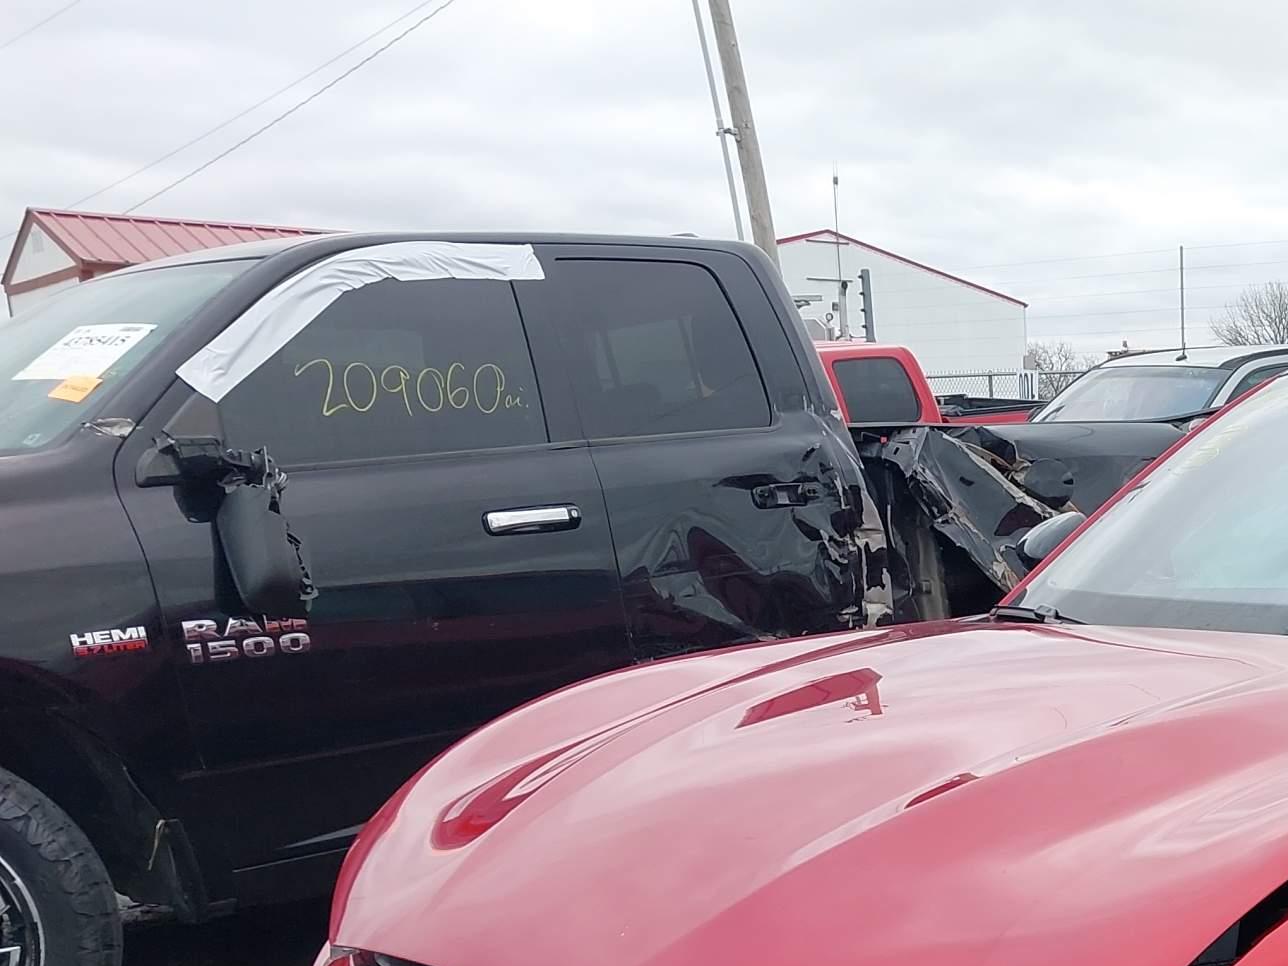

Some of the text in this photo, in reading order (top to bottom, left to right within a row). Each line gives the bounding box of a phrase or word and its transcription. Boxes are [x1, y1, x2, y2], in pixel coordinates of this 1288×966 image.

[69, 625, 147, 647] HEMI
[181, 615, 307, 640] RAM
[186, 632, 312, 663] 1500
